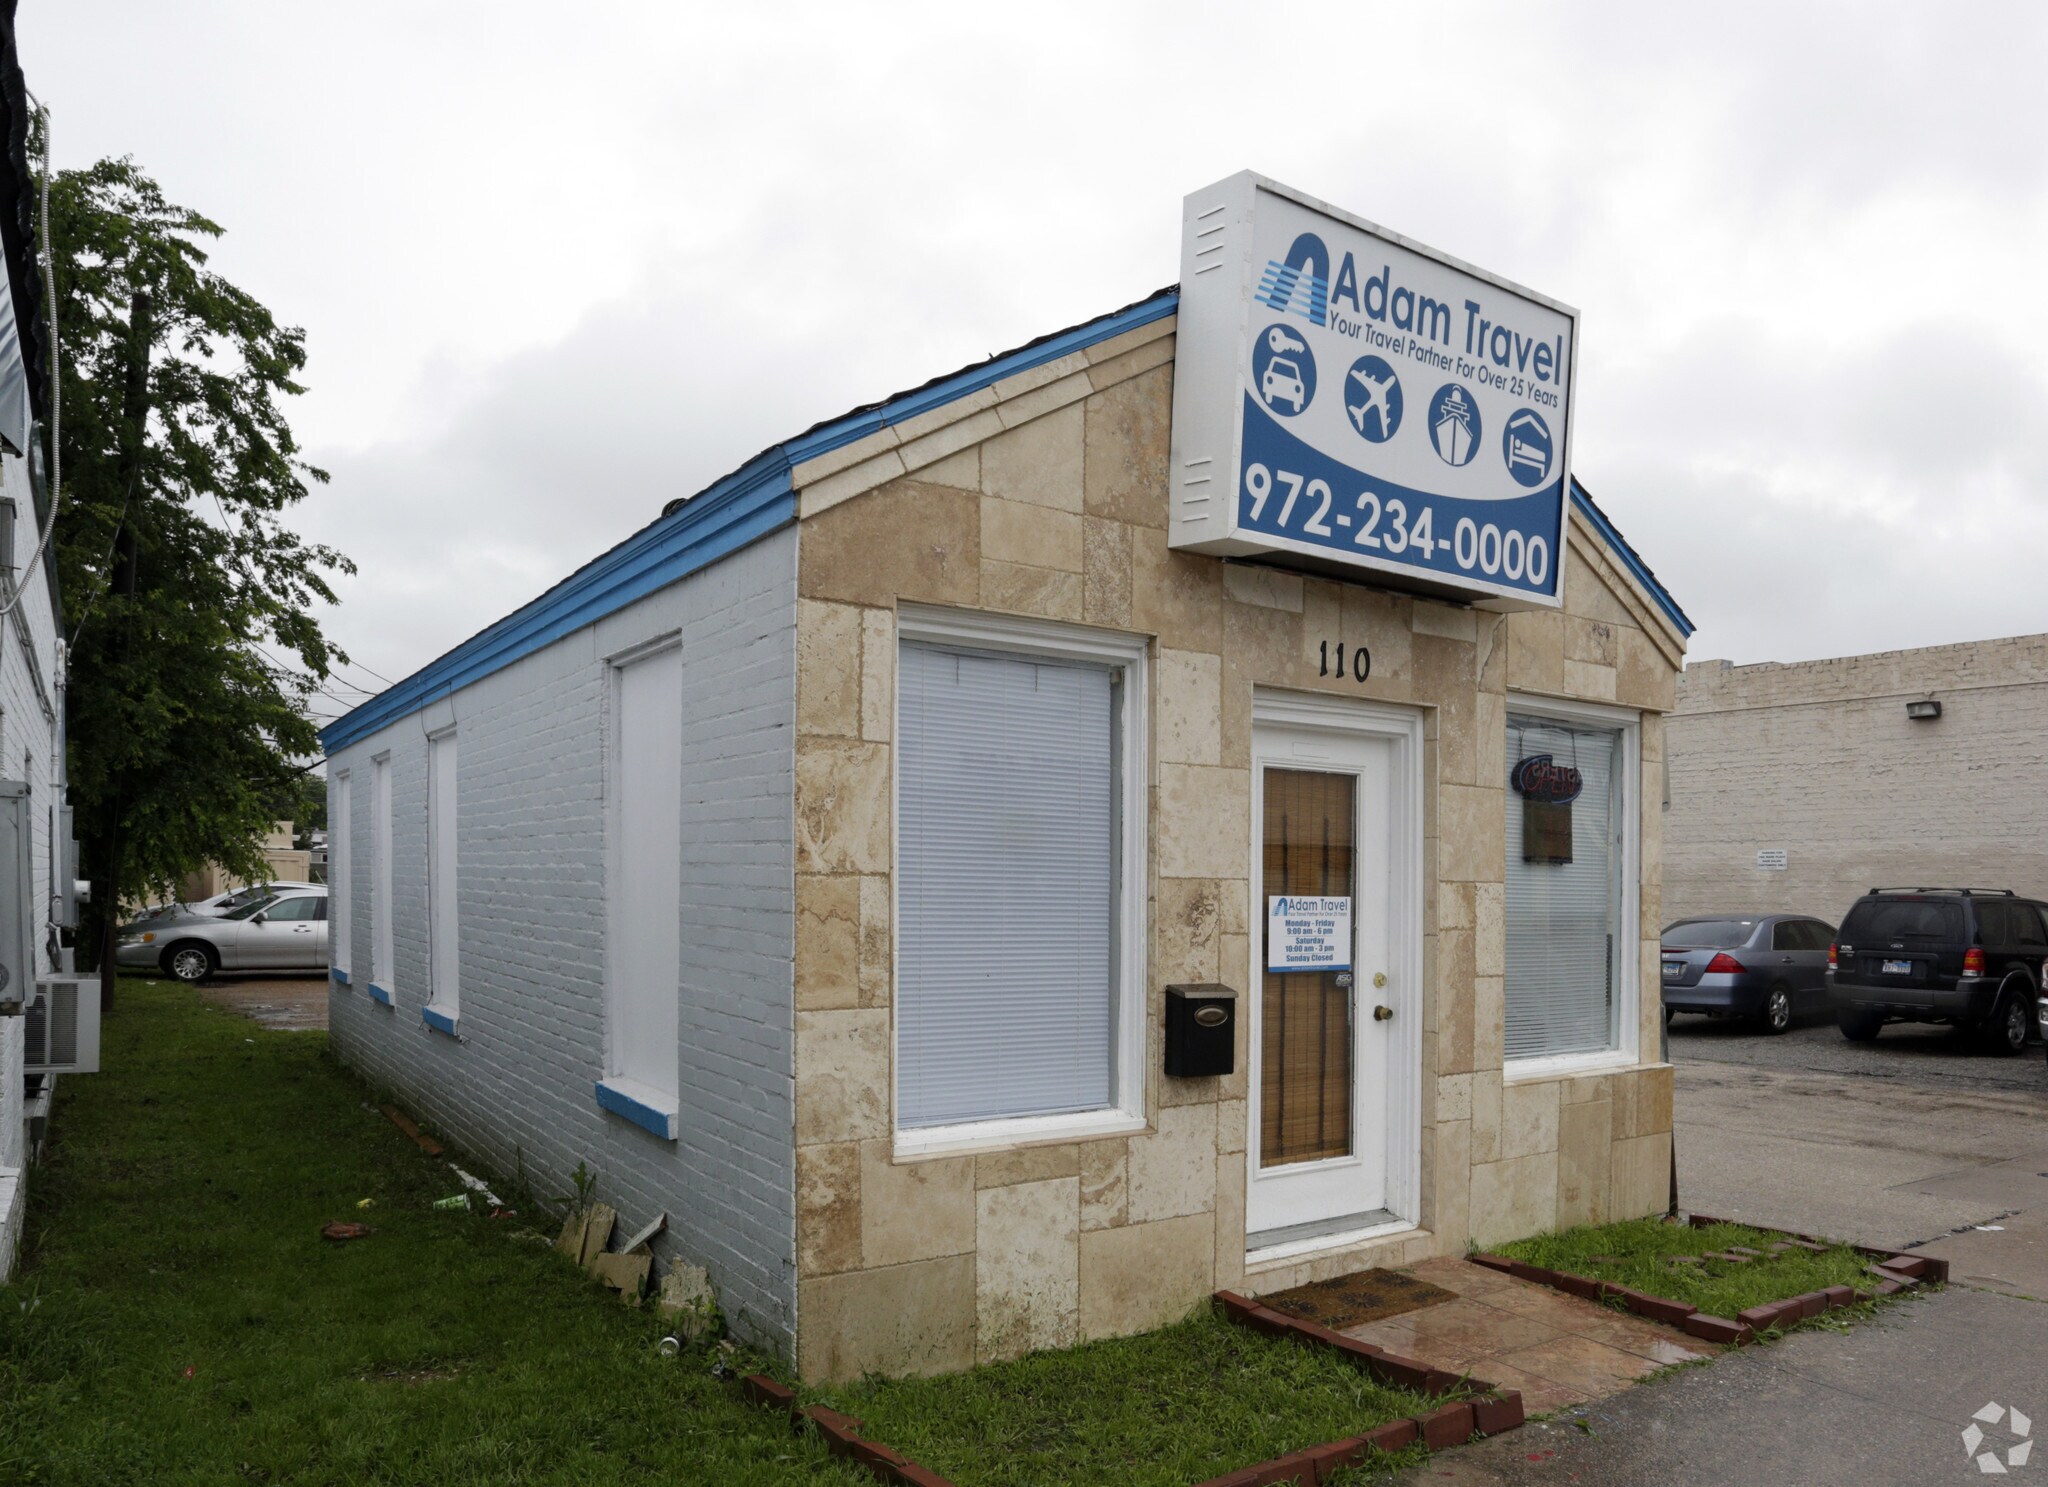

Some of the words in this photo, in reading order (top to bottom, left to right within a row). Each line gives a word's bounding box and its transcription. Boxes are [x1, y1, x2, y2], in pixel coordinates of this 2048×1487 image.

[1331, 251, 1451, 345] Adam
[1464, 298, 1563, 386] Travel
[1330, 310, 1362, 340] Your
[1365, 329, 1405, 355] Travel
[1408, 341, 1453, 371] Partner
[1456, 357, 1475, 378] For
[1478, 365, 1507, 391] Over
[1509, 376, 1523, 396] 25
[1527, 382, 1558, 409] Years
[1245, 462, 1549, 586] 972-234-0000
[1319, 640, 1371, 683] 110
[1288, 898, 1317, 911] Adam
[1320, 899, 1348, 911] Travel
[1296, 937, 1324, 945] Saturday
